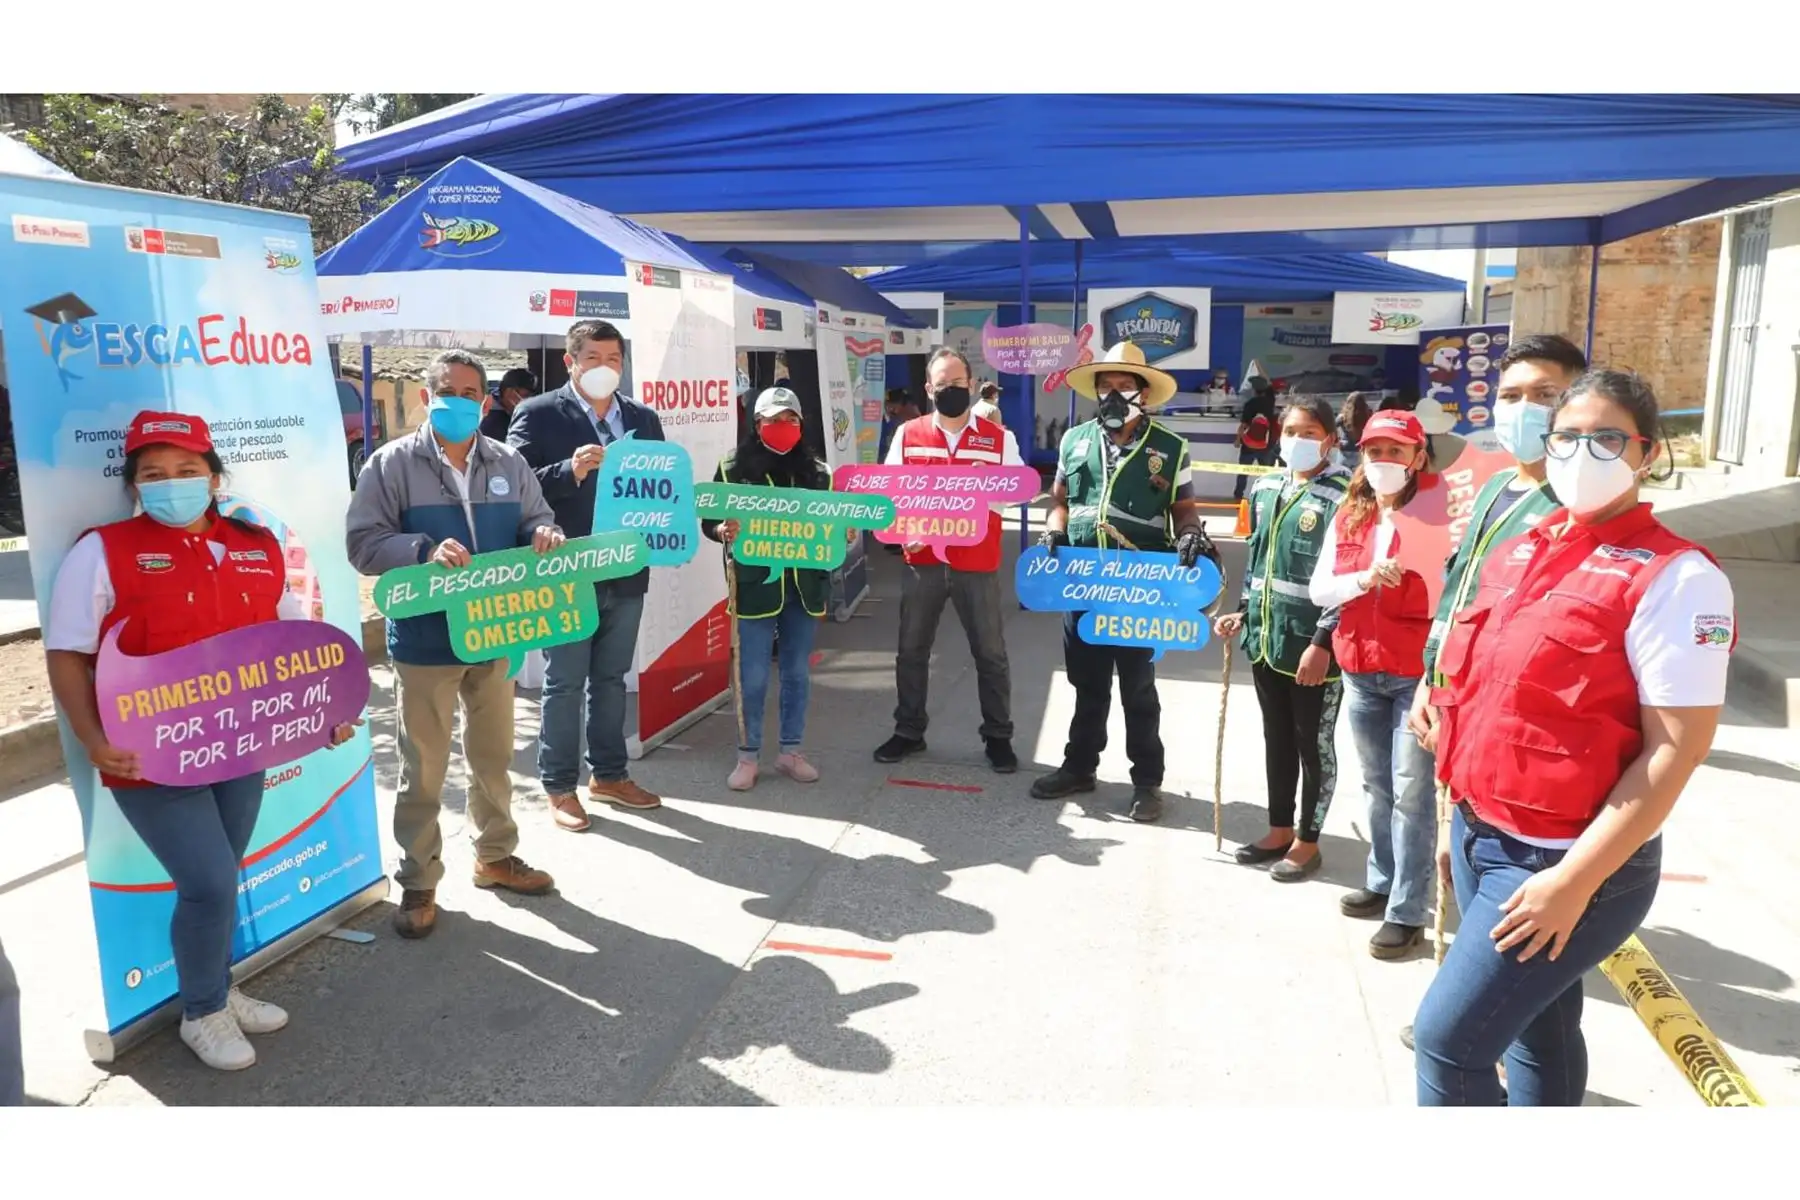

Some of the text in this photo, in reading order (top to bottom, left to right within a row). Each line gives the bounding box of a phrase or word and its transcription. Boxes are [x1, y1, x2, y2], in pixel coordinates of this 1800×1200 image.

[438, 194, 461, 203] COMER
[465, 184, 501, 194] NACIONAL
[1042, 335, 1070, 346] SALUD
[642, 380, 729, 411] PRODUCE
[209, 417, 252, 433] entación
[254, 415, 305, 430] saludable
[239, 433, 284, 449] pescado
[619, 453, 677, 474] ¡COME
[613, 475, 680, 504] SANO,
[846, 473, 1020, 492] ¡SUBE TUS DEFENSAS
[725, 493, 801, 514] PESCADO
[806, 501, 887, 520] CONTIENE
[892, 494, 976, 511] COMIENDO
[622, 511, 673, 527] COME
[750, 518, 834, 540] HIERRO Y
[641, 532, 687, 551] ADO!
[743, 540, 832, 562] OMEGA 3!
[385, 542, 638, 610] ¡EL PESCADO CONTIENE
[1027, 555, 1202, 584] ¡YO ME ALIMENTO
[466, 582, 576, 623] HIERRO Y
[1062, 583, 1179, 607] COMIENDO...
[464, 610, 582, 652] OMEGA 3!
[1094, 614, 1200, 644] PESCADO!
[116, 643, 345, 722] PRIMERO MI SALUD
[155, 716, 205, 749] POR
[214, 707, 241, 731] TI,
[252, 692, 295, 722] POR
[179, 706, 325, 774] POR EL PERÚ
[264, 765, 303, 790] SCADO
